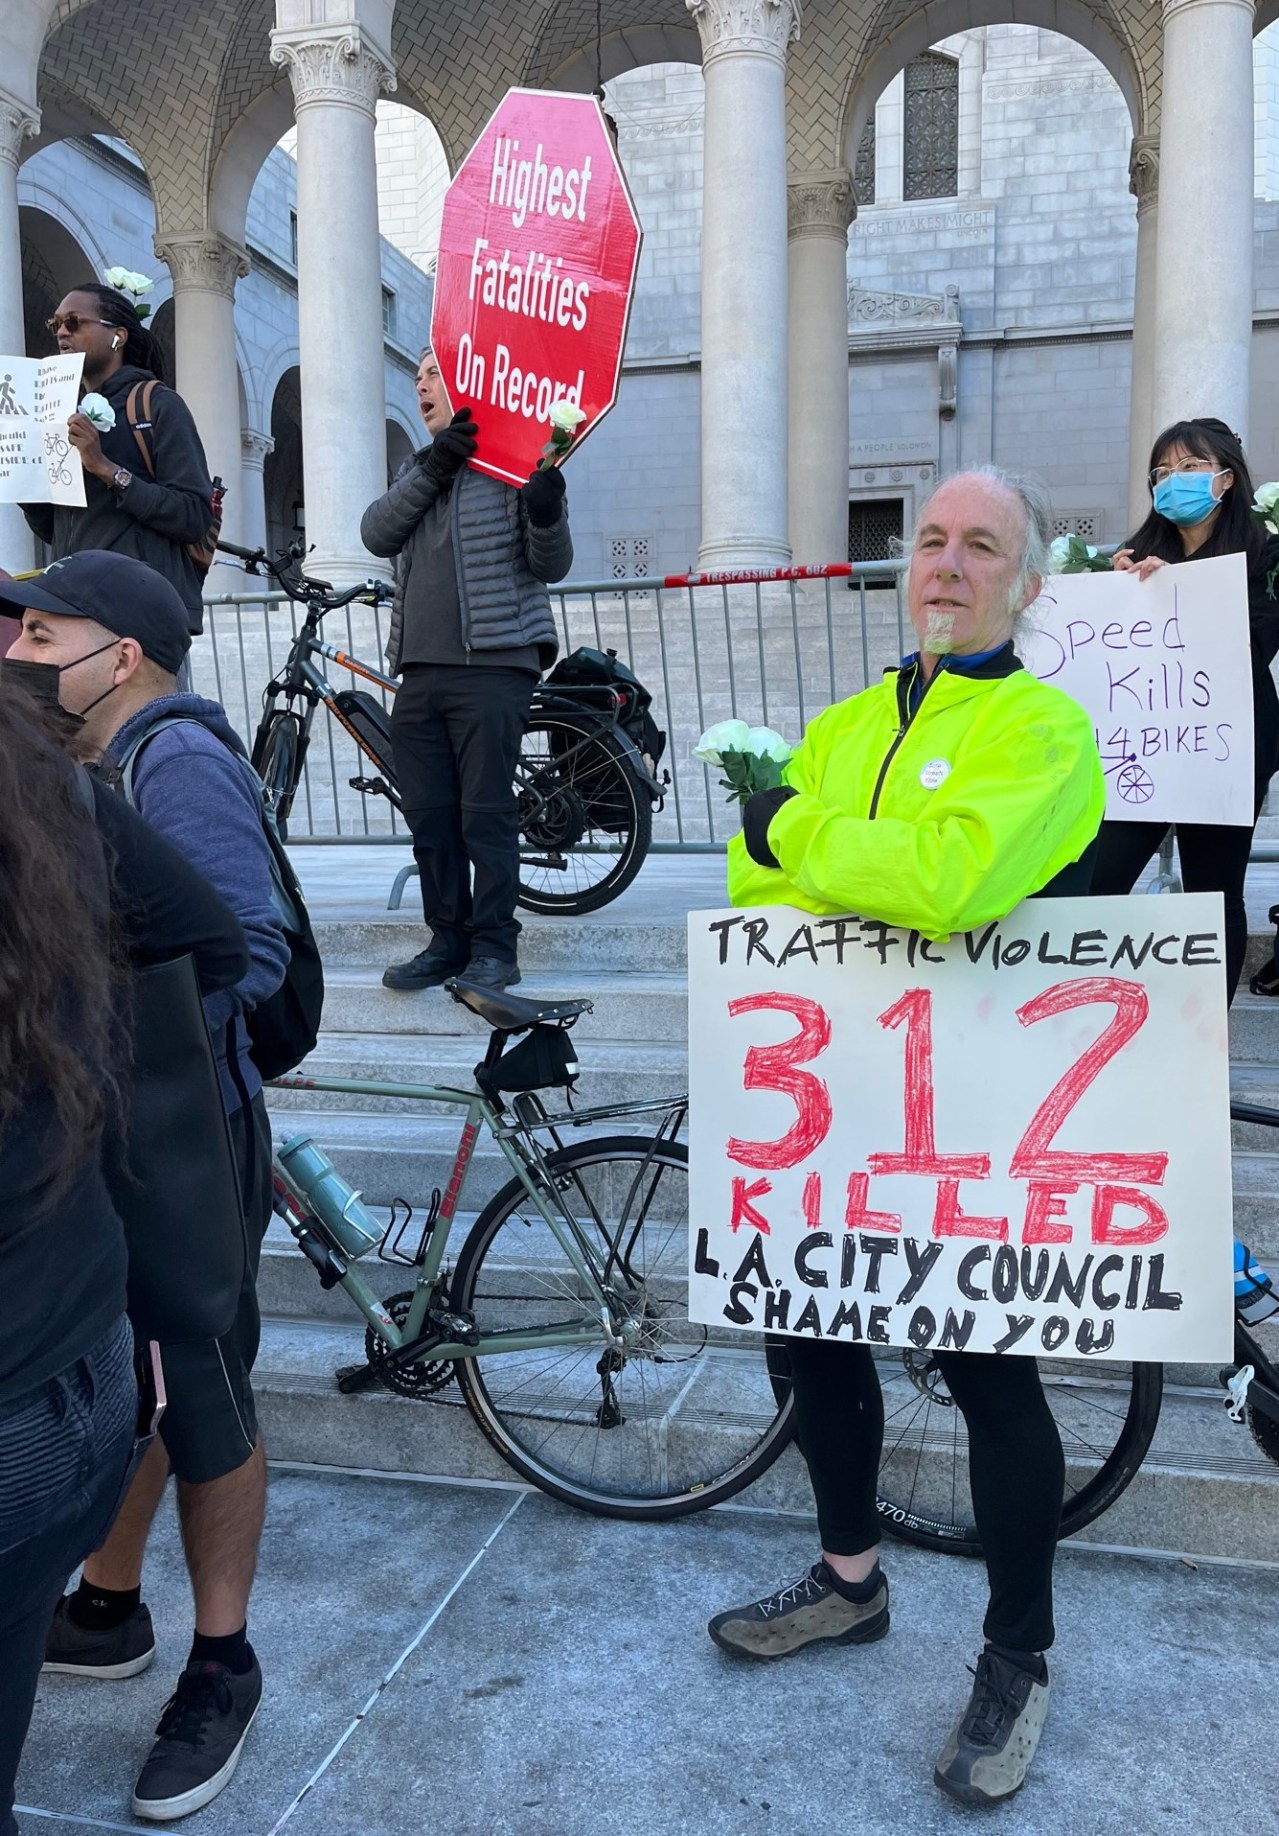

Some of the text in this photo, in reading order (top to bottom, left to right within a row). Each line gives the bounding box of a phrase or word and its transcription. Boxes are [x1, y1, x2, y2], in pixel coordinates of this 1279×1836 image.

[489, 137, 592, 228] Highest
[853, 212, 990, 237] RIGHT MAKES MIGHT
[469, 238, 590, 331] Fatalities
[455, 333, 586, 434] On Record
[706, 568, 776, 583] TRESPASSING
[806, 564, 828, 575] 602
[1106, 661, 1211, 712] Kills
[1141, 723, 1232, 762] BIKES
[709, 917, 1222, 970] TRAFFIC VIOLENCE
[727, 975, 1168, 1185] 312
[727, 1171, 1169, 1245] KILLED
[793, 1231, 945, 1306] CITY
[957, 1244, 1183, 1311] COUNCIL
[723, 1282, 1115, 1355] SHAME ON YOU
